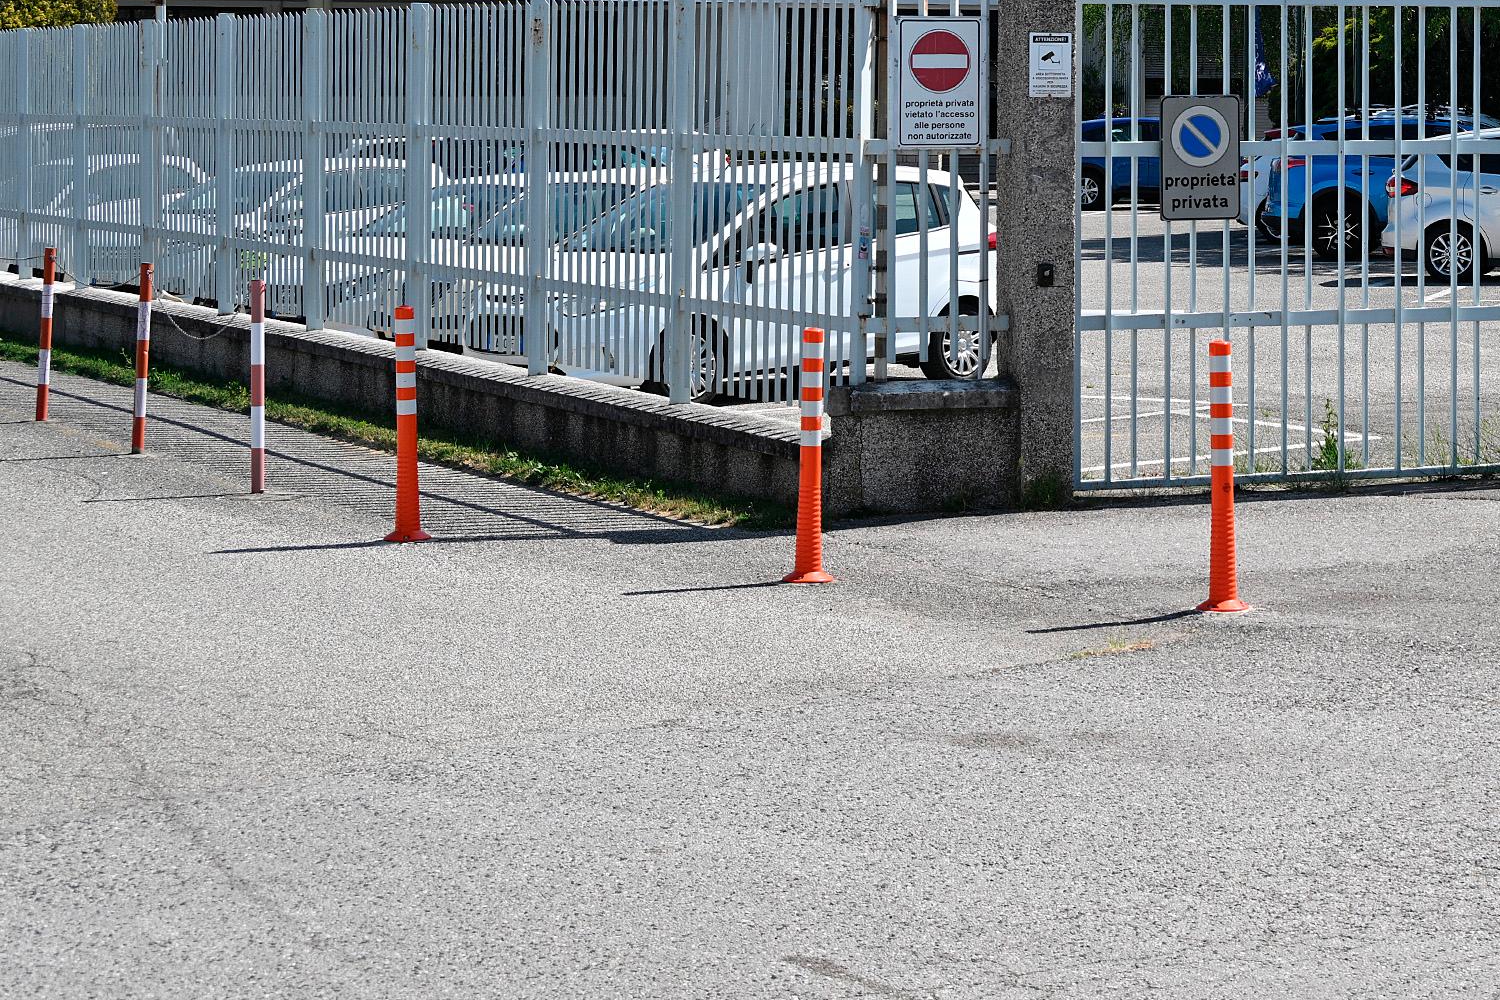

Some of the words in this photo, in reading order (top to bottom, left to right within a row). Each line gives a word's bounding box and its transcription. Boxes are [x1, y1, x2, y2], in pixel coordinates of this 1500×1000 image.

[905, 99, 943, 108] proprietà
[945, 99, 975, 108] privata
[935, 110, 975, 118] l'accesso
[914, 121, 929, 129] alle
[931, 122, 966, 130] persone
[926, 132, 972, 140] autorizzate
[1172, 195, 1229, 212] privata
